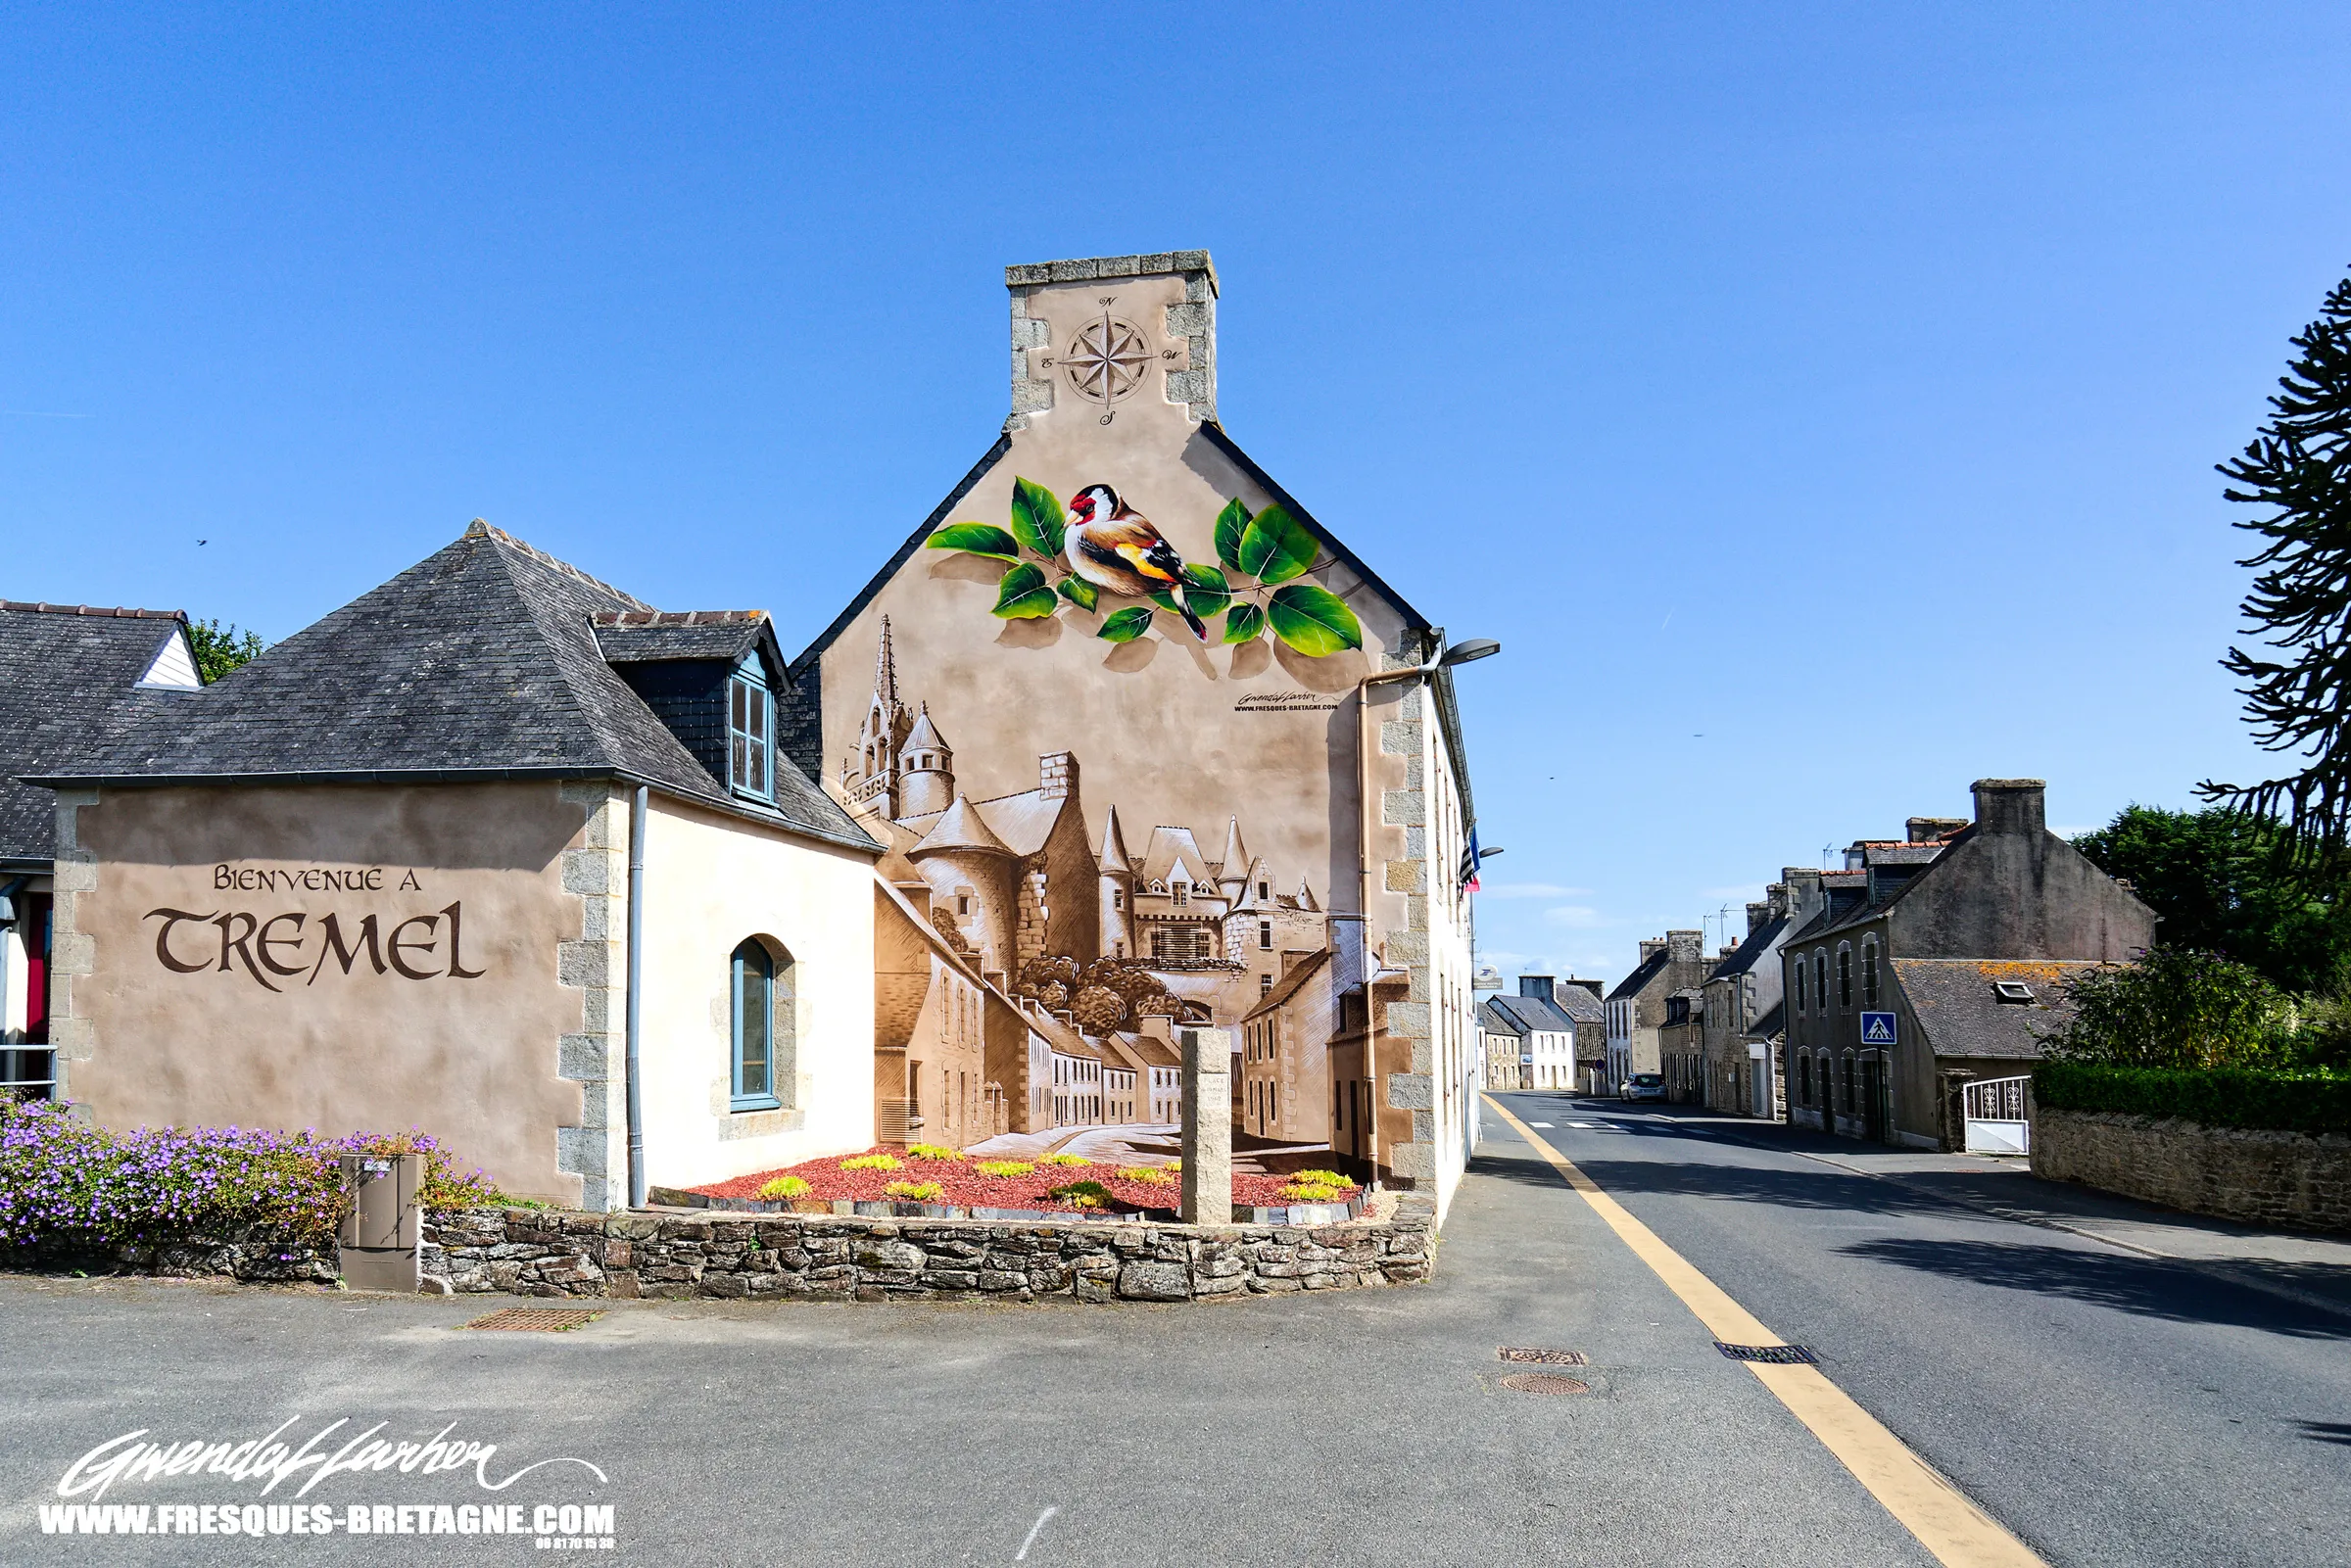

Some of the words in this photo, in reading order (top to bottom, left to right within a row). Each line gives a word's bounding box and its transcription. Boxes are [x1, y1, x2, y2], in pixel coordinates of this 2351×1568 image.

[1098, 297, 1117, 307] N
[1161, 350, 1182, 360] W
[1040, 357, 1055, 368] E
[1099, 410, 1117, 426] S
[399, 869, 422, 891] A
[142, 900, 487, 993] TREMEL
